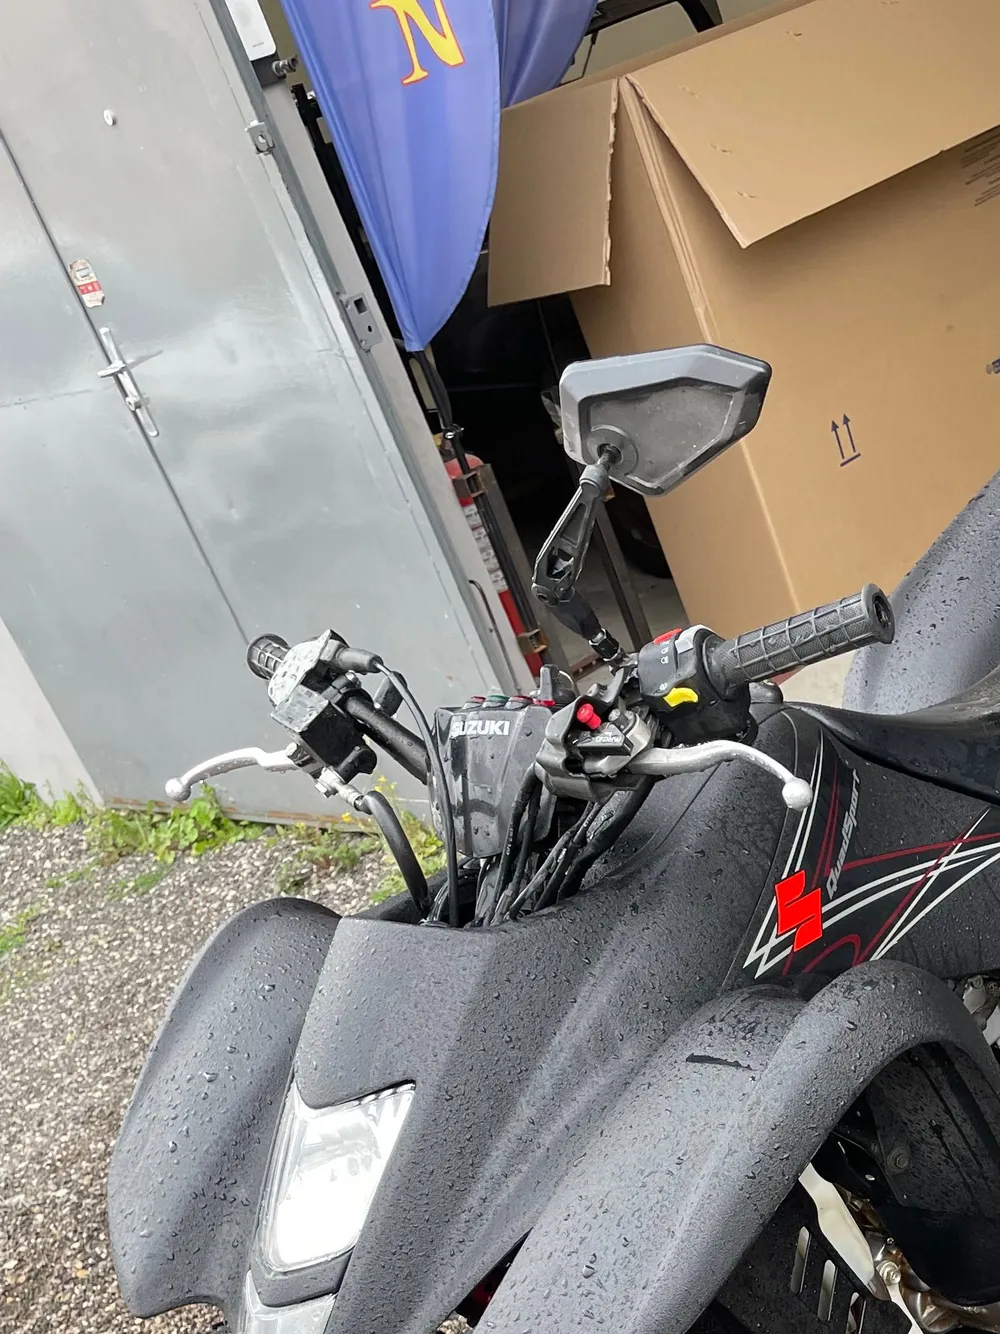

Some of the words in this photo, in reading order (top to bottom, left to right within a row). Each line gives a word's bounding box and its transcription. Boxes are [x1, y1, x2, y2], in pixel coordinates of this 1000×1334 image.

[370, 0, 464, 85] N
[450, 719, 511, 737] SUZUKI
[826, 767, 861, 900] QuadSport
